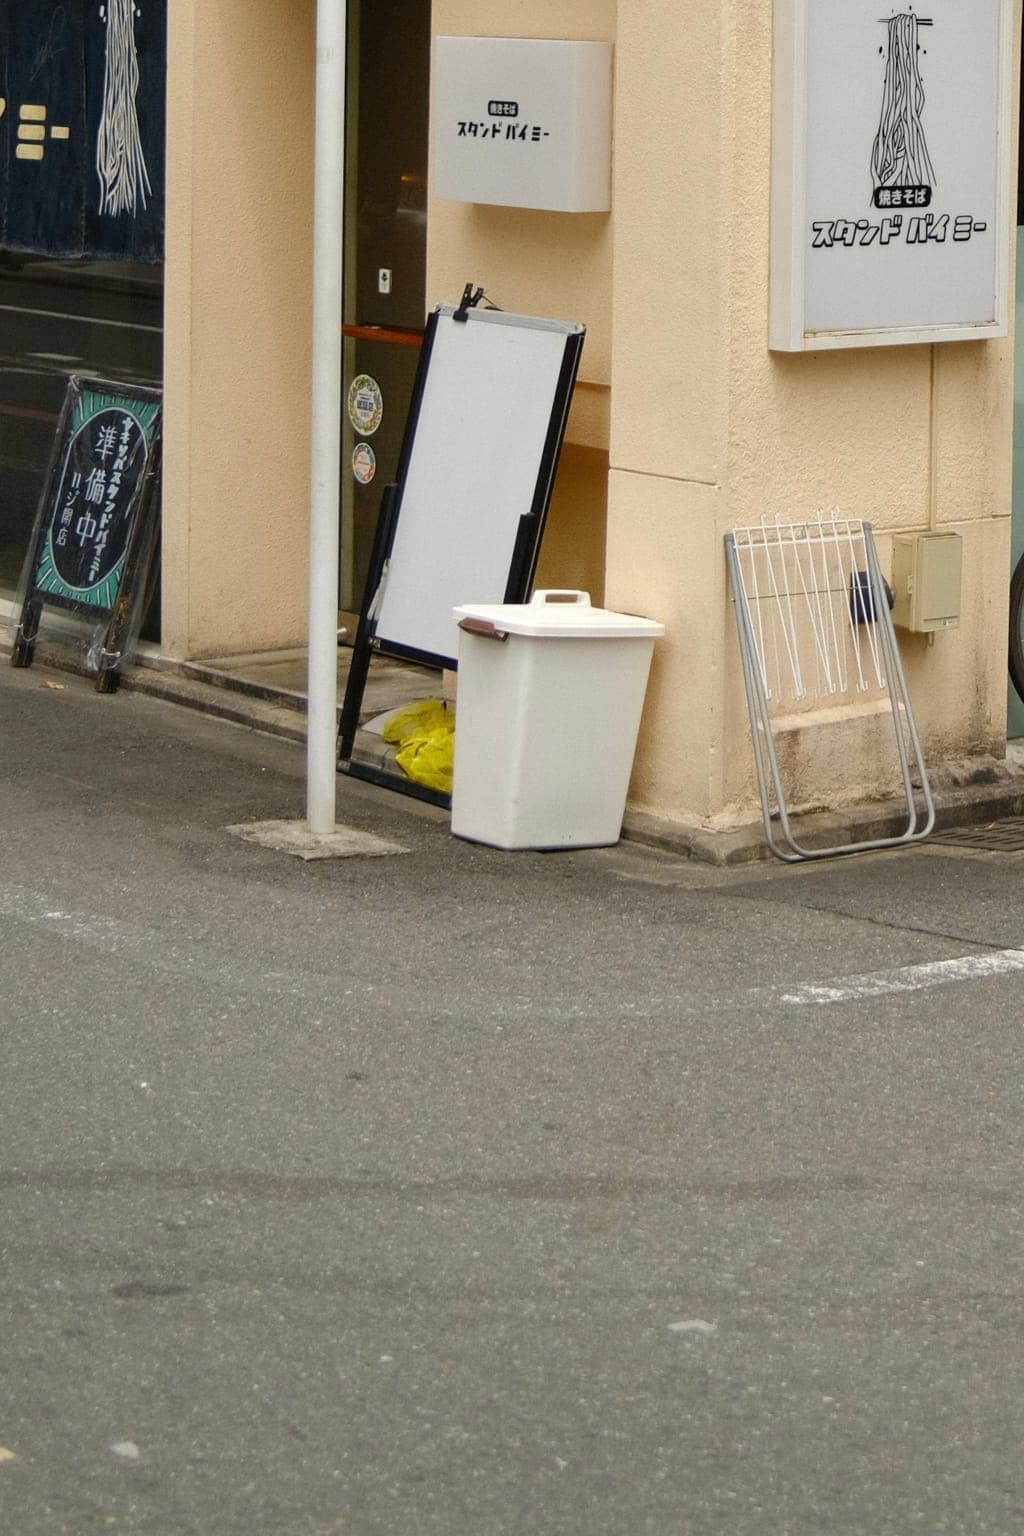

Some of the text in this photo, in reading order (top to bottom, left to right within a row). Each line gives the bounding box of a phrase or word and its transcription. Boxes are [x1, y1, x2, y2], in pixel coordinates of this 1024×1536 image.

[0, 97, 70, 161] ミー
[878, 188, 927, 206] 焼きそば
[812, 214, 987, 247] スタンドバイミー
[76, 424, 119, 548] 準備中
